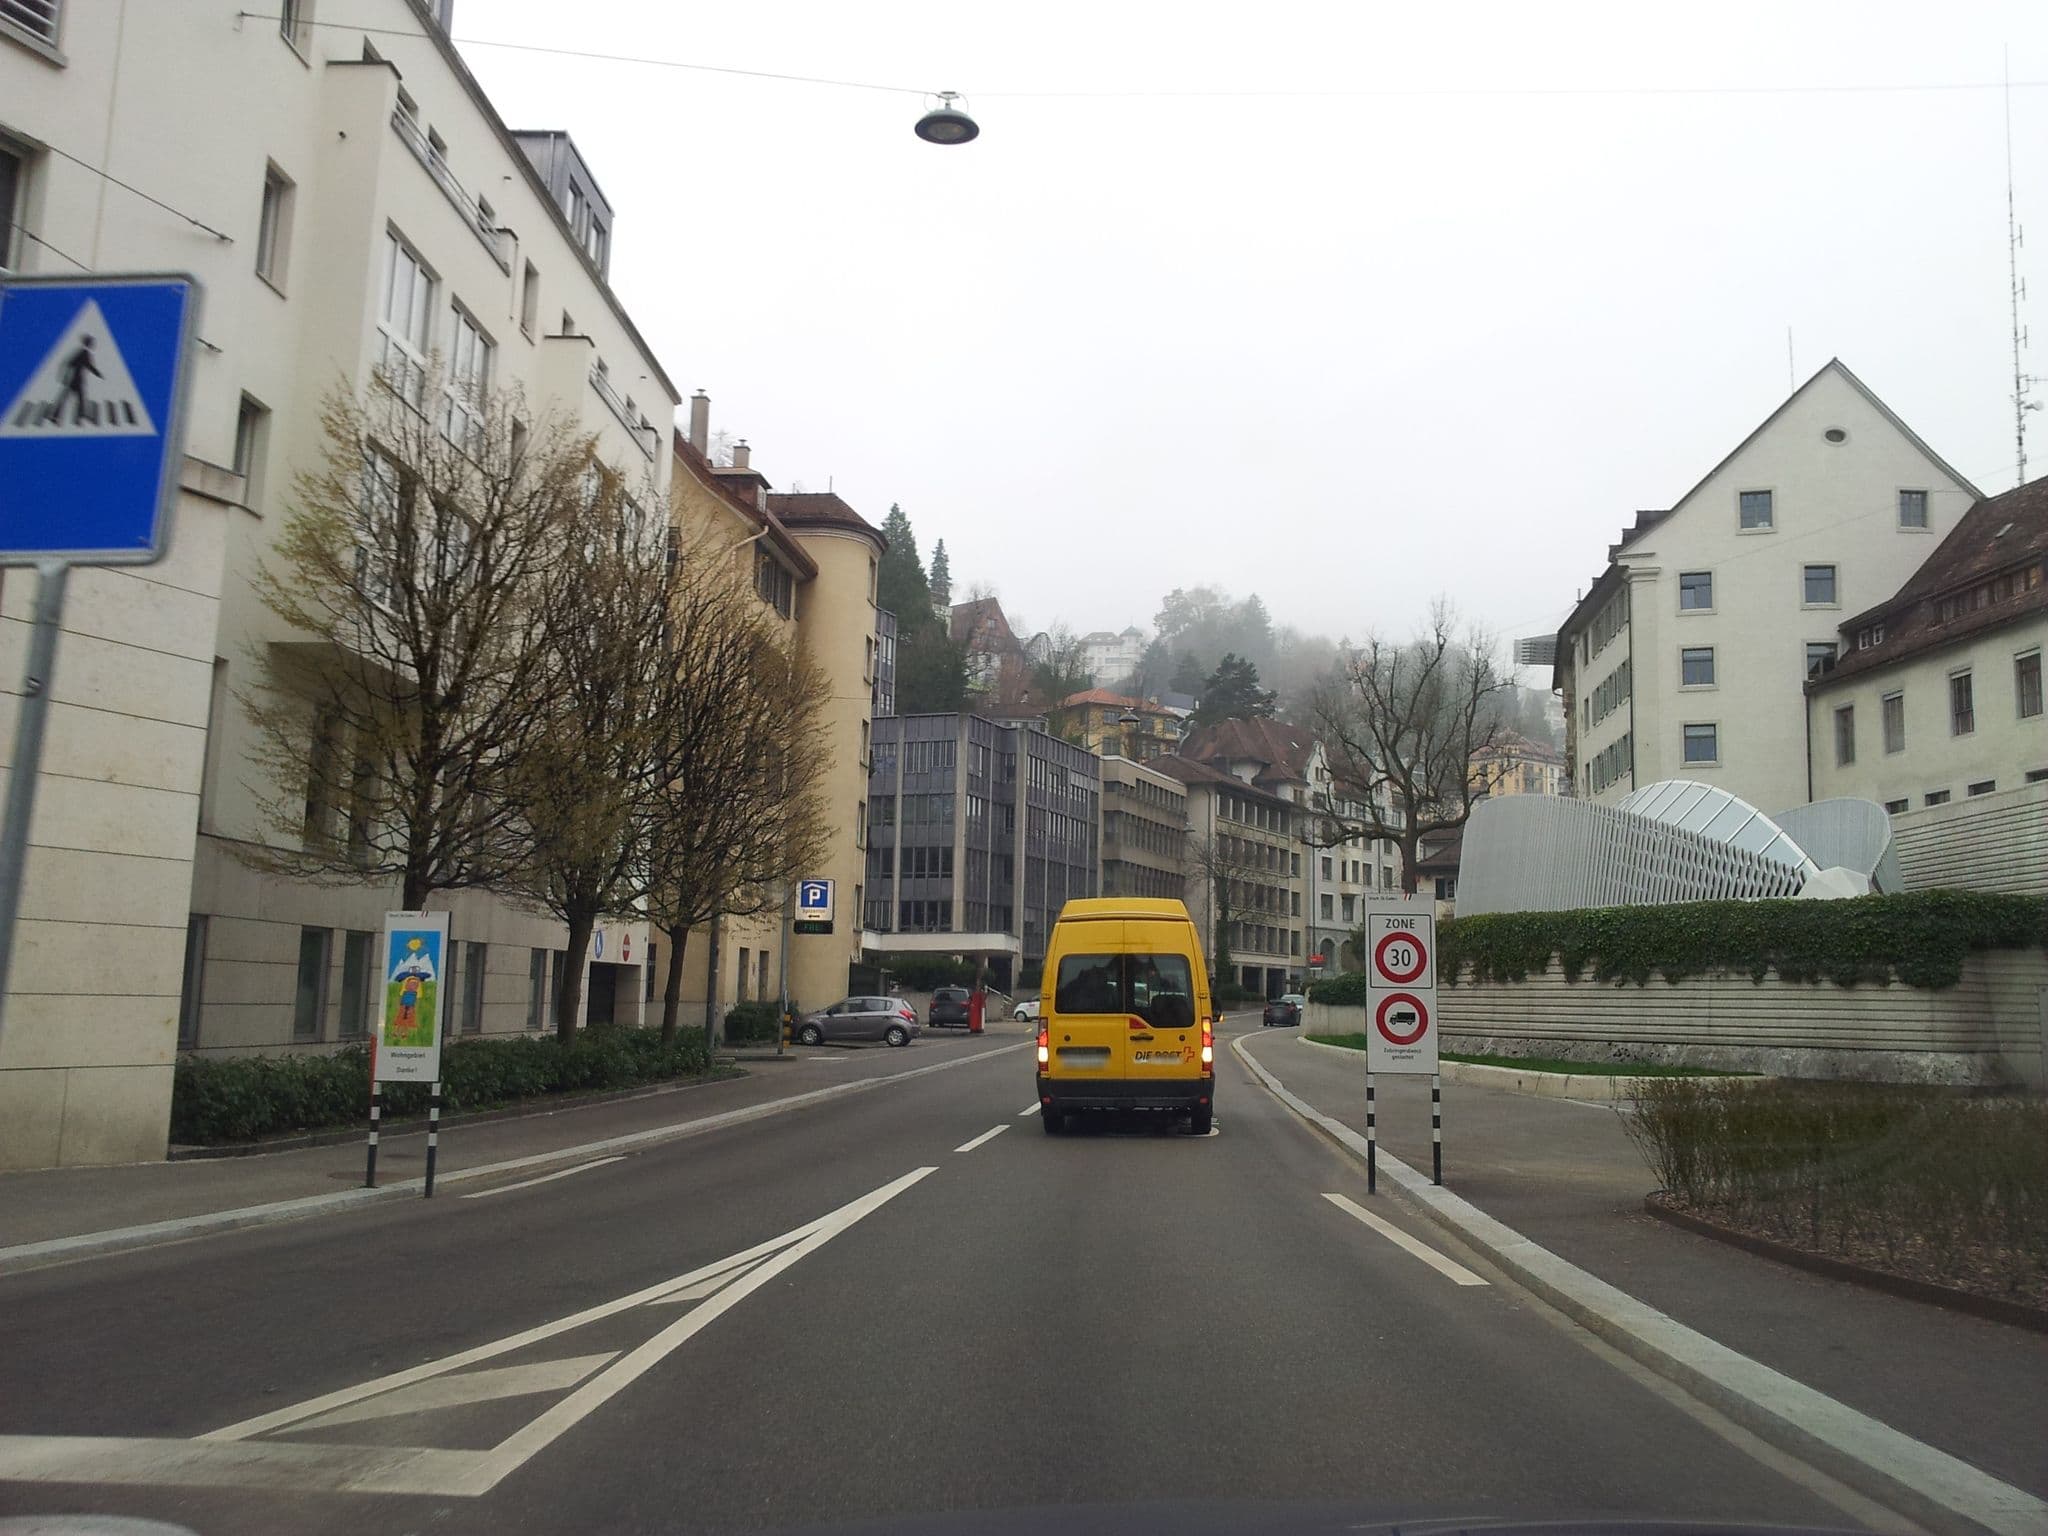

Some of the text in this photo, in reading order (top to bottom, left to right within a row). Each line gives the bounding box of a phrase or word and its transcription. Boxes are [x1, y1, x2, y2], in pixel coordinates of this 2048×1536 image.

[809, 889, 820, 905] P
[1385, 918, 1416, 929] ZONE
[1390, 948, 1411, 967] 30
